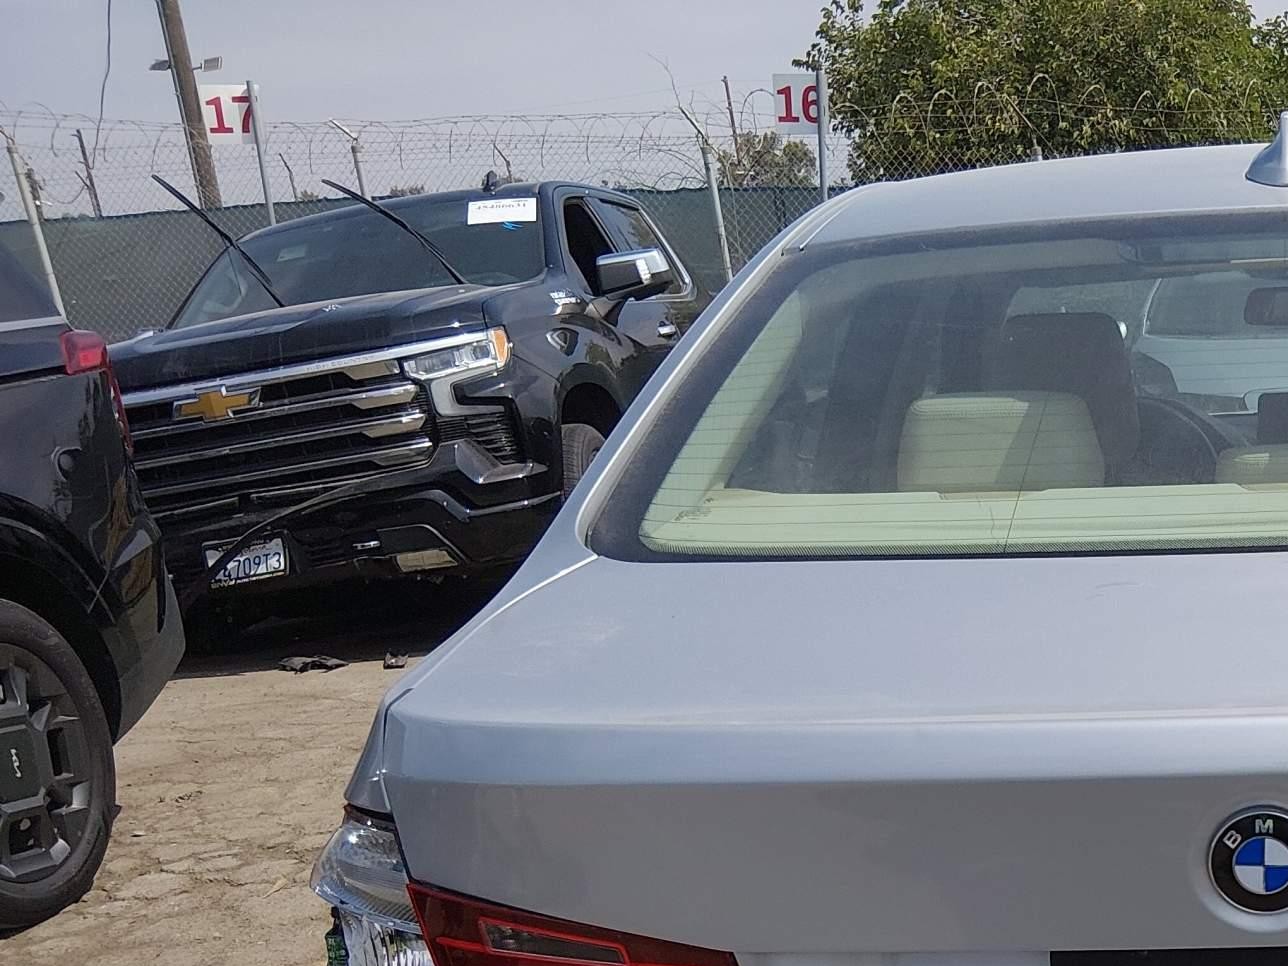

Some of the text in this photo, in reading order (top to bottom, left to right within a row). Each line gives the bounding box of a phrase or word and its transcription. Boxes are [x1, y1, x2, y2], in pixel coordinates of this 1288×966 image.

[205, 96, 254, 134] 17
[776, 85, 818, 124] 16
[218, 551, 283, 580] 4709T3
